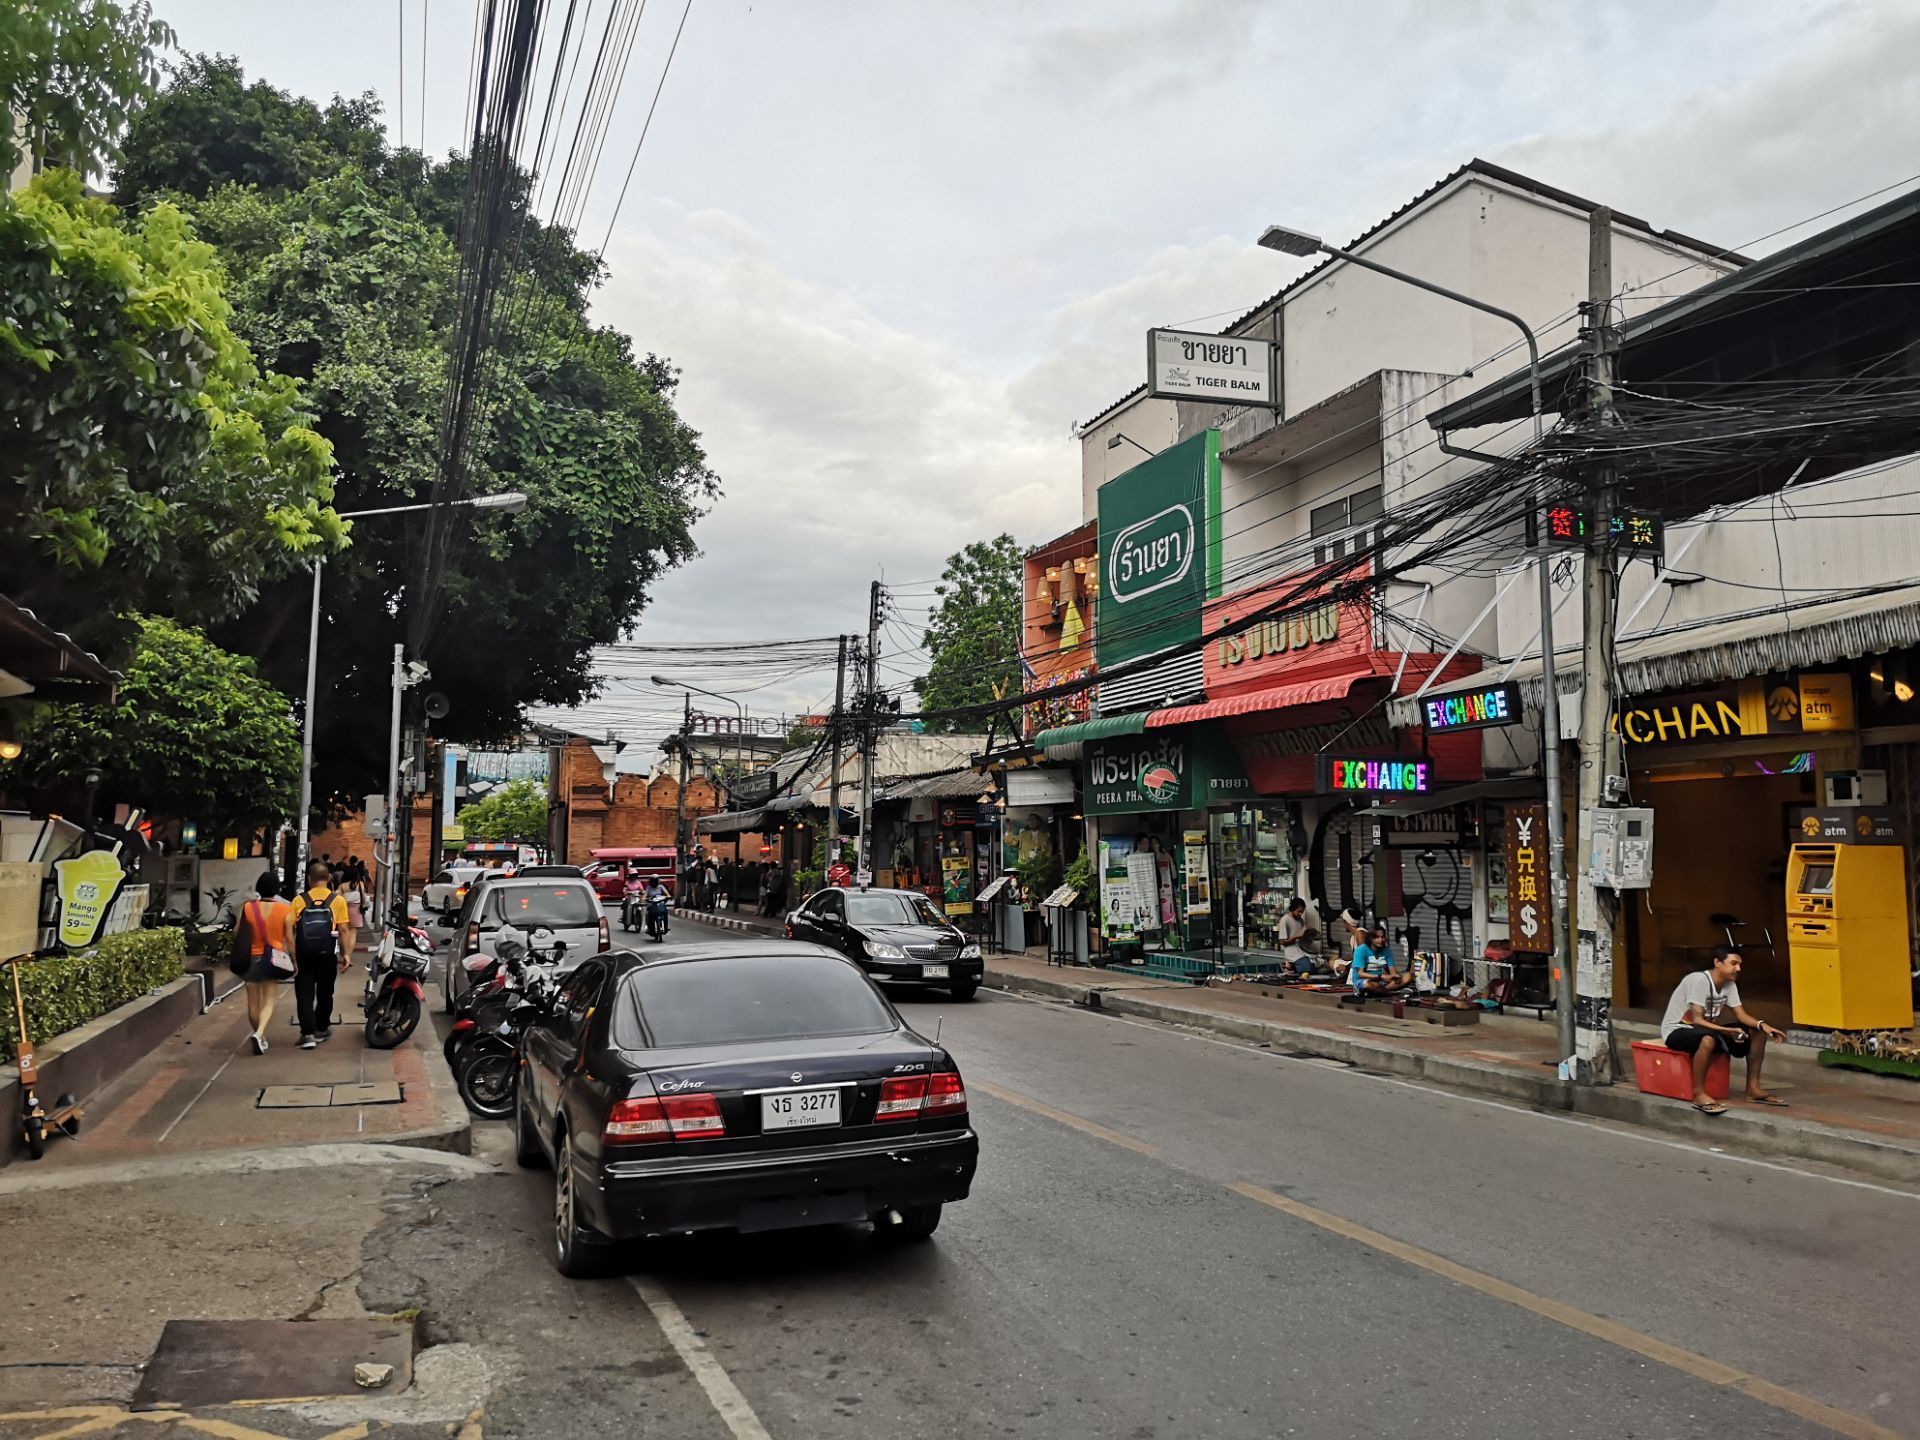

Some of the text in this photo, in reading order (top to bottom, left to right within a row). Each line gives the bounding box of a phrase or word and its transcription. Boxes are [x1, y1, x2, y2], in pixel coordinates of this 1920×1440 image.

[1181, 341, 1247, 366] ขายยา
[1195, 376, 1260, 391] TIGER BALM
[1121, 531, 1181, 582] ร้านยา
[1426, 691, 1507, 728] EXCHANGE
[1806, 701, 1832, 714] atm
[1210, 777, 1248, 788] ขายยา
[1333, 761, 1426, 791] EXCHANGE
[1096, 792, 1122, 804] PEERA
[1824, 826, 1847, 836] atm
[1875, 827, 1894, 836] atm
[69, 902, 98, 913] Mango
[67, 911, 95, 919] Smoothie
[66, 918, 80, 928] 59
[659, 1079, 706, 1093] Cefiro
[800, 1093, 836, 1111] 3277
